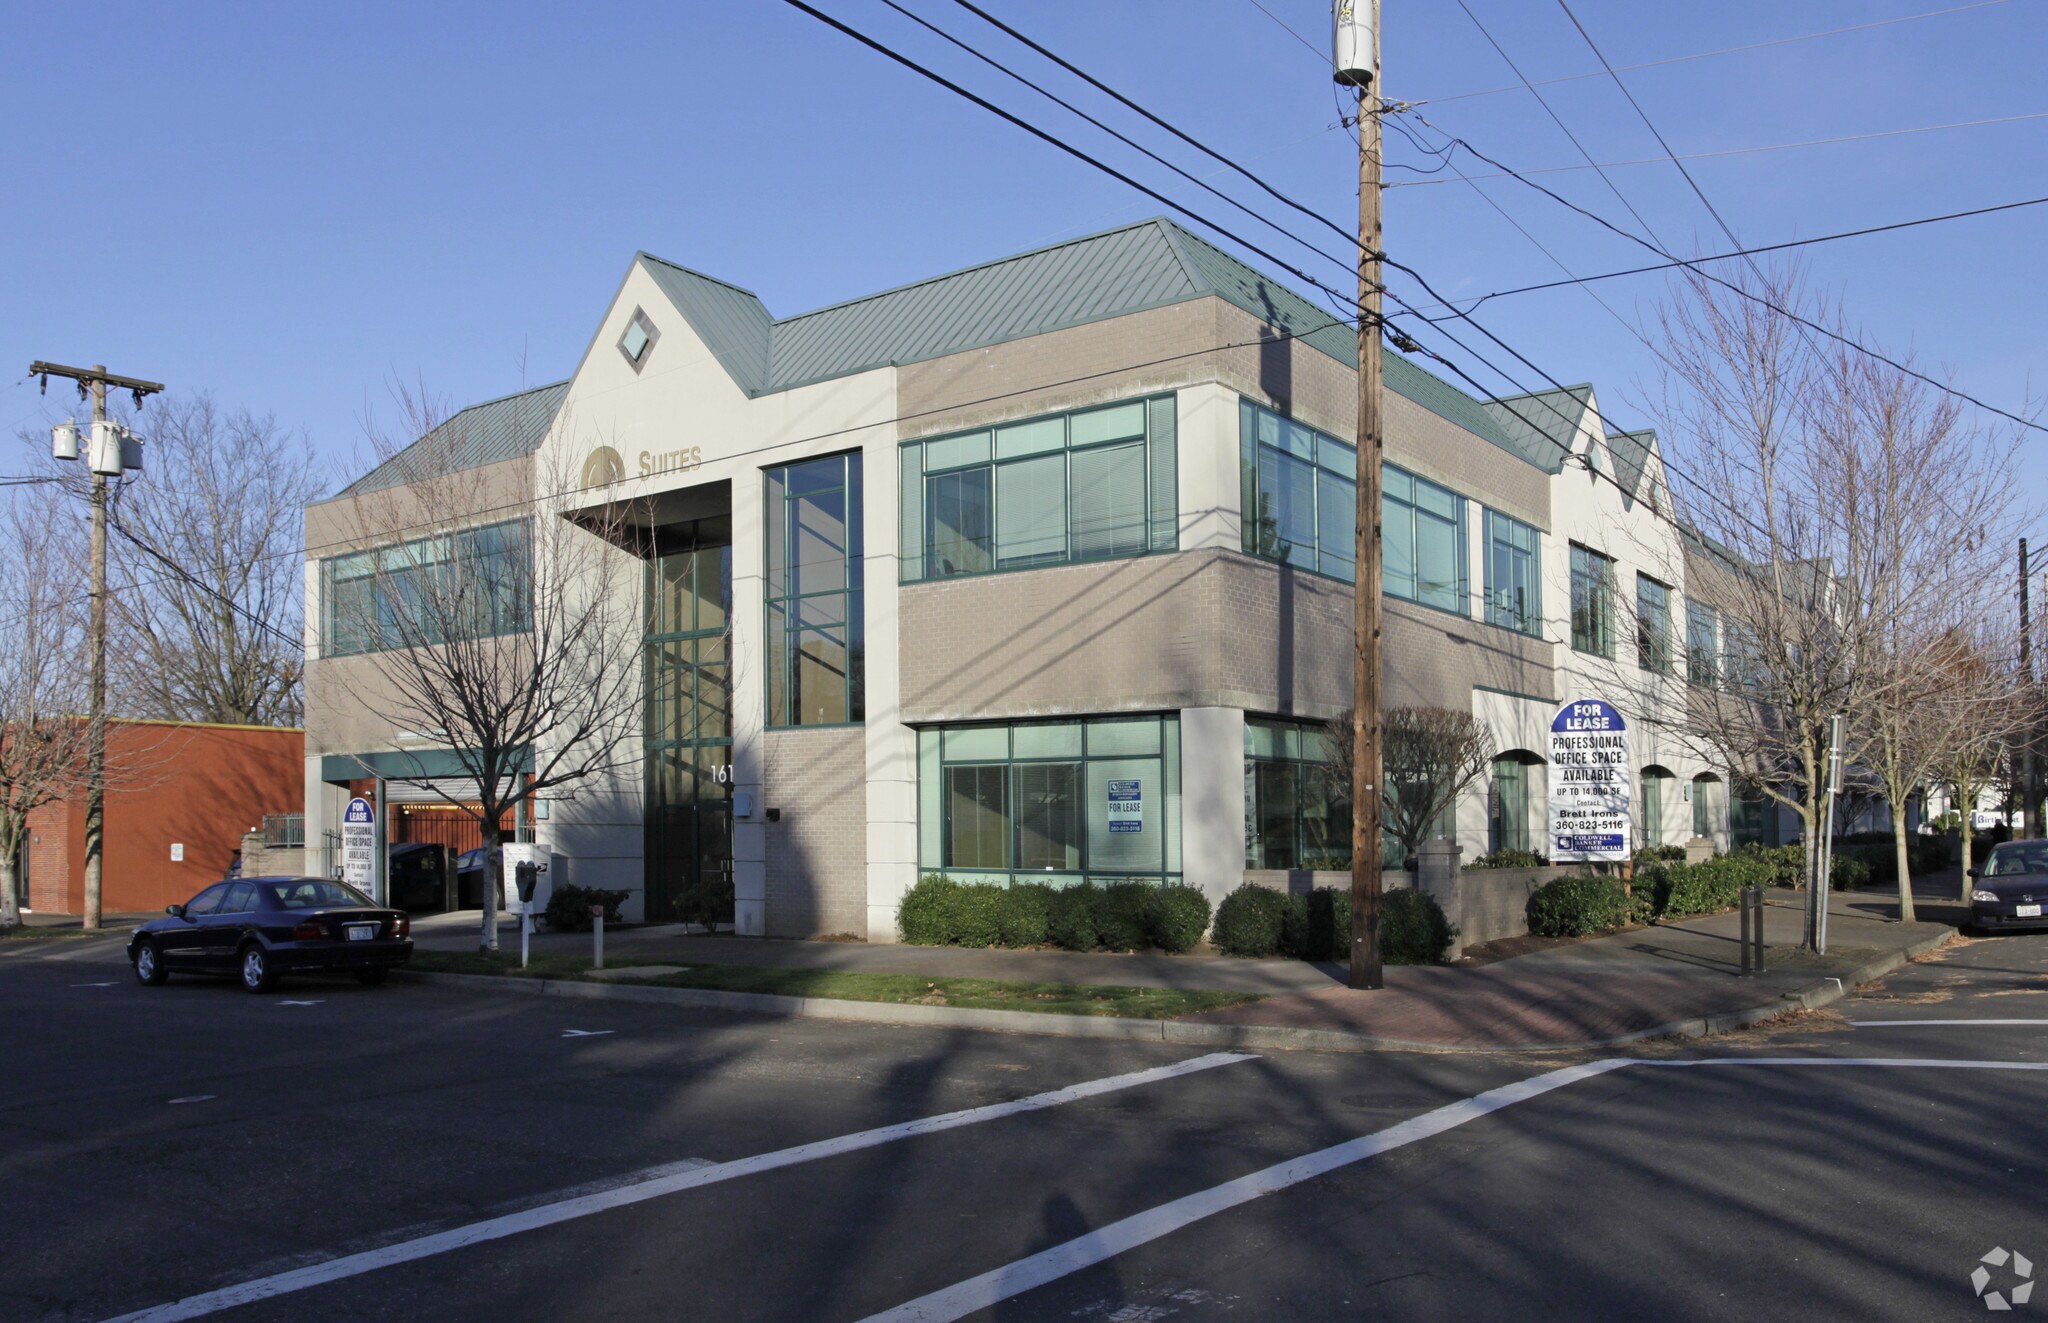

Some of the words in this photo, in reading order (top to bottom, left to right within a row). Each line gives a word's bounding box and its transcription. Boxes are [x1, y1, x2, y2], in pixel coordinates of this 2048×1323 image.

[1573, 704, 1602, 716] FOR
[1566, 717, 1610, 730] LEASE
[1552, 736, 1624, 750] PROFESSIONAL
[1555, 752, 1587, 765] OFFICE
[1591, 751, 1622, 764] SPACE
[1563, 769, 1615, 781] AVAILABLE
[1556, 788, 1567, 796] UP
[1570, 788, 1580, 796] TO
[1610, 787, 1622, 795] SF
[352, 802, 364, 811] FOR
[1109, 803, 1121, 813] FOR
[1123, 802, 1141, 812] LEASE
[349, 812, 367, 821] LEASE
[1560, 810, 1587, 818] Brett
[1591, 809, 1619, 818] Irons
[1555, 820, 1623, 830] 360-823-5116
[344, 826, 373, 835] PROFESSIONAL
[345, 837, 358, 847] OFFICE
[359, 838, 372, 847] SPACE
[348, 850, 370, 860] AVAILABLE
